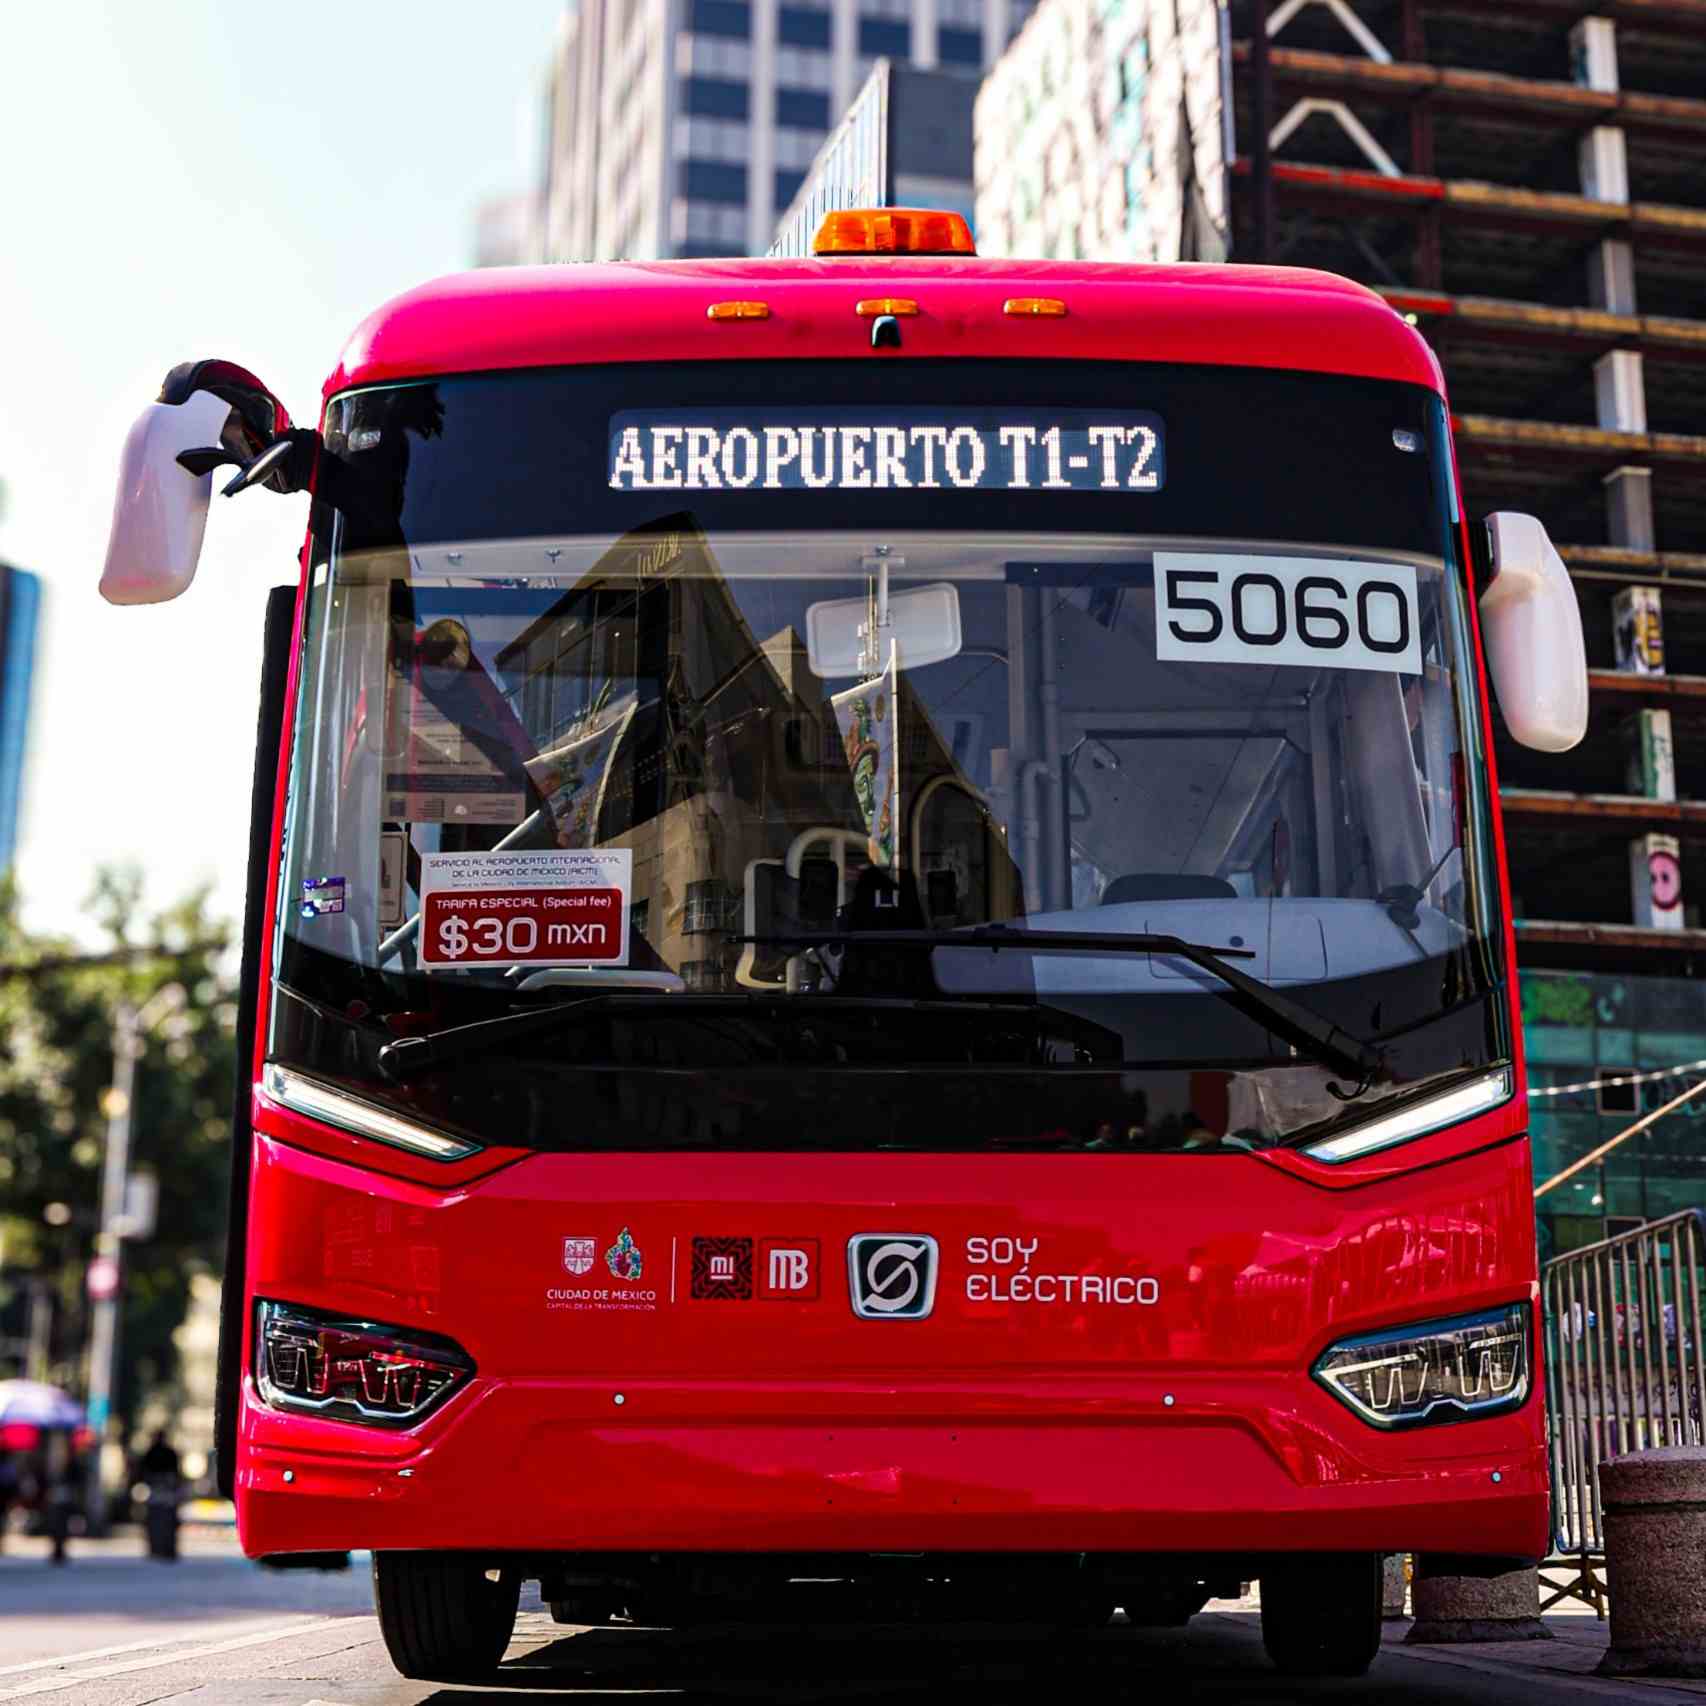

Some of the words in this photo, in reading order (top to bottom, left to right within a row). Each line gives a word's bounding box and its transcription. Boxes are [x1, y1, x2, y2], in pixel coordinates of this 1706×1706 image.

[608, 427, 986, 487] AEROPUERTO
[1000, 427, 1159, 487] T1-T2
[1166, 570, 1410, 654] 5060
[430, 858, 470, 868] SERVICIO
[472, 858, 483, 866] AL
[486, 856, 548, 866] AEROPUERTO
[452, 870, 465, 878] DE
[467, 869, 479, 878] LA
[481, 868, 514, 877] CIUDAD
[516, 867, 529, 876] DE
[437, 898, 478, 910] TARIFA
[480, 896, 539, 909] ESPECIAL
[543, 896, 587, 910] (Special
[589, 895, 612, 908] fee)
[438, 914, 538, 959] $30
[548, 923, 607, 945] mxn
[966, 1237, 1038, 1264] SOY
[768, 1248, 809, 1290] MB
[546, 1288, 592, 1300] CIUDAD
[593, 1289, 609, 1300] DE
[966, 1266, 1159, 1304] ELÉCTRICO
[546, 1302, 574, 1310] CAPITAL
